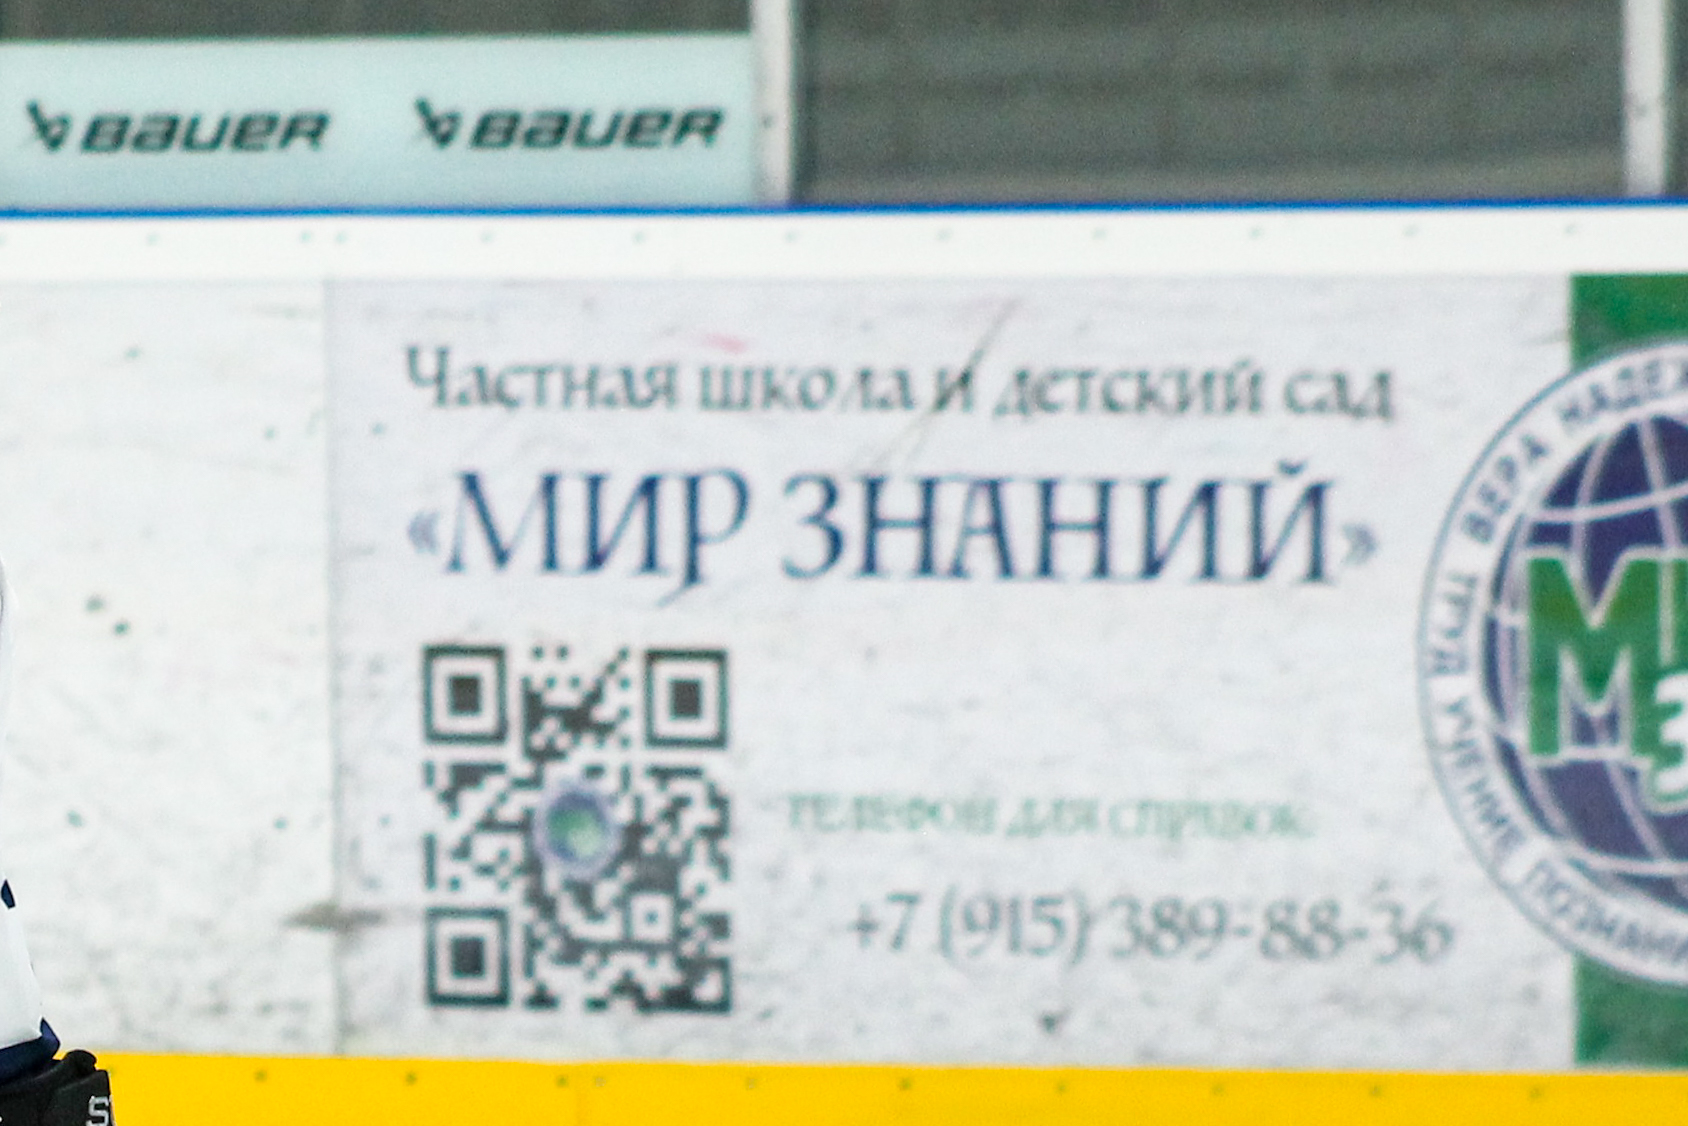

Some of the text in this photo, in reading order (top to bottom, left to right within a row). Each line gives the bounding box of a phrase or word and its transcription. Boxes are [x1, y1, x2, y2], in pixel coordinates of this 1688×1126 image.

[78, 111, 331, 153] BAUER
[468, 107, 725, 150] BAUER
[404, 343, 1396, 423] Частная школа и детский сад
[1559, 358, 1688, 428] НАДЕ
[407, 458, 1379, 606] «МИР ЗНАНИЙ»
[847, 883, 1456, 970] +7 (915) 389-88-36
